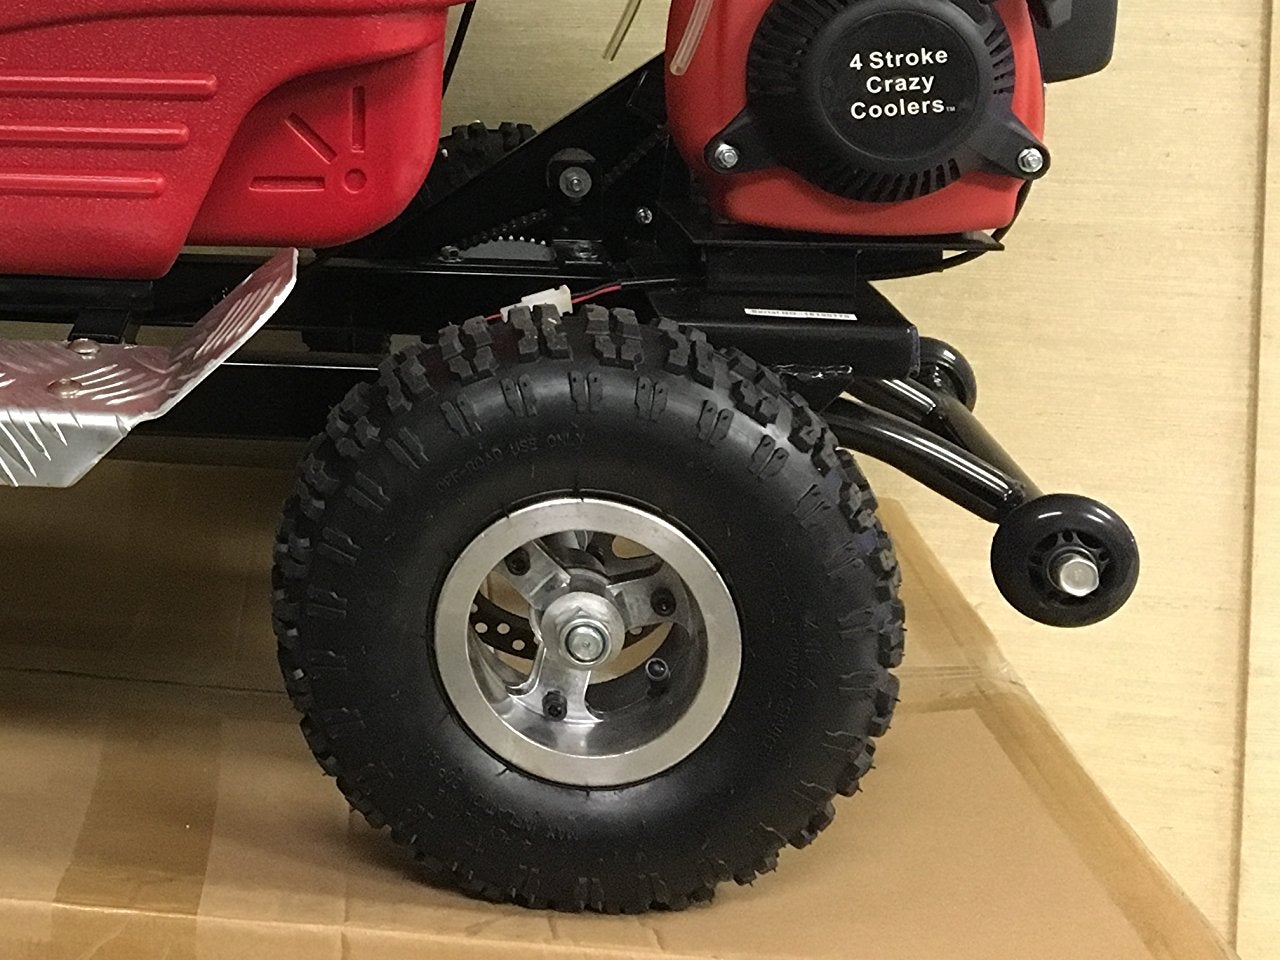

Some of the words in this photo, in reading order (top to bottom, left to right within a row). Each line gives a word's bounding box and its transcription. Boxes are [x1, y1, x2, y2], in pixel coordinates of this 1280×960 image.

[849, 53, 863, 71] 4
[868, 47, 948, 69] Stroke
[866, 75, 935, 94] Crazy
[850, 98, 945, 120] Coolers
